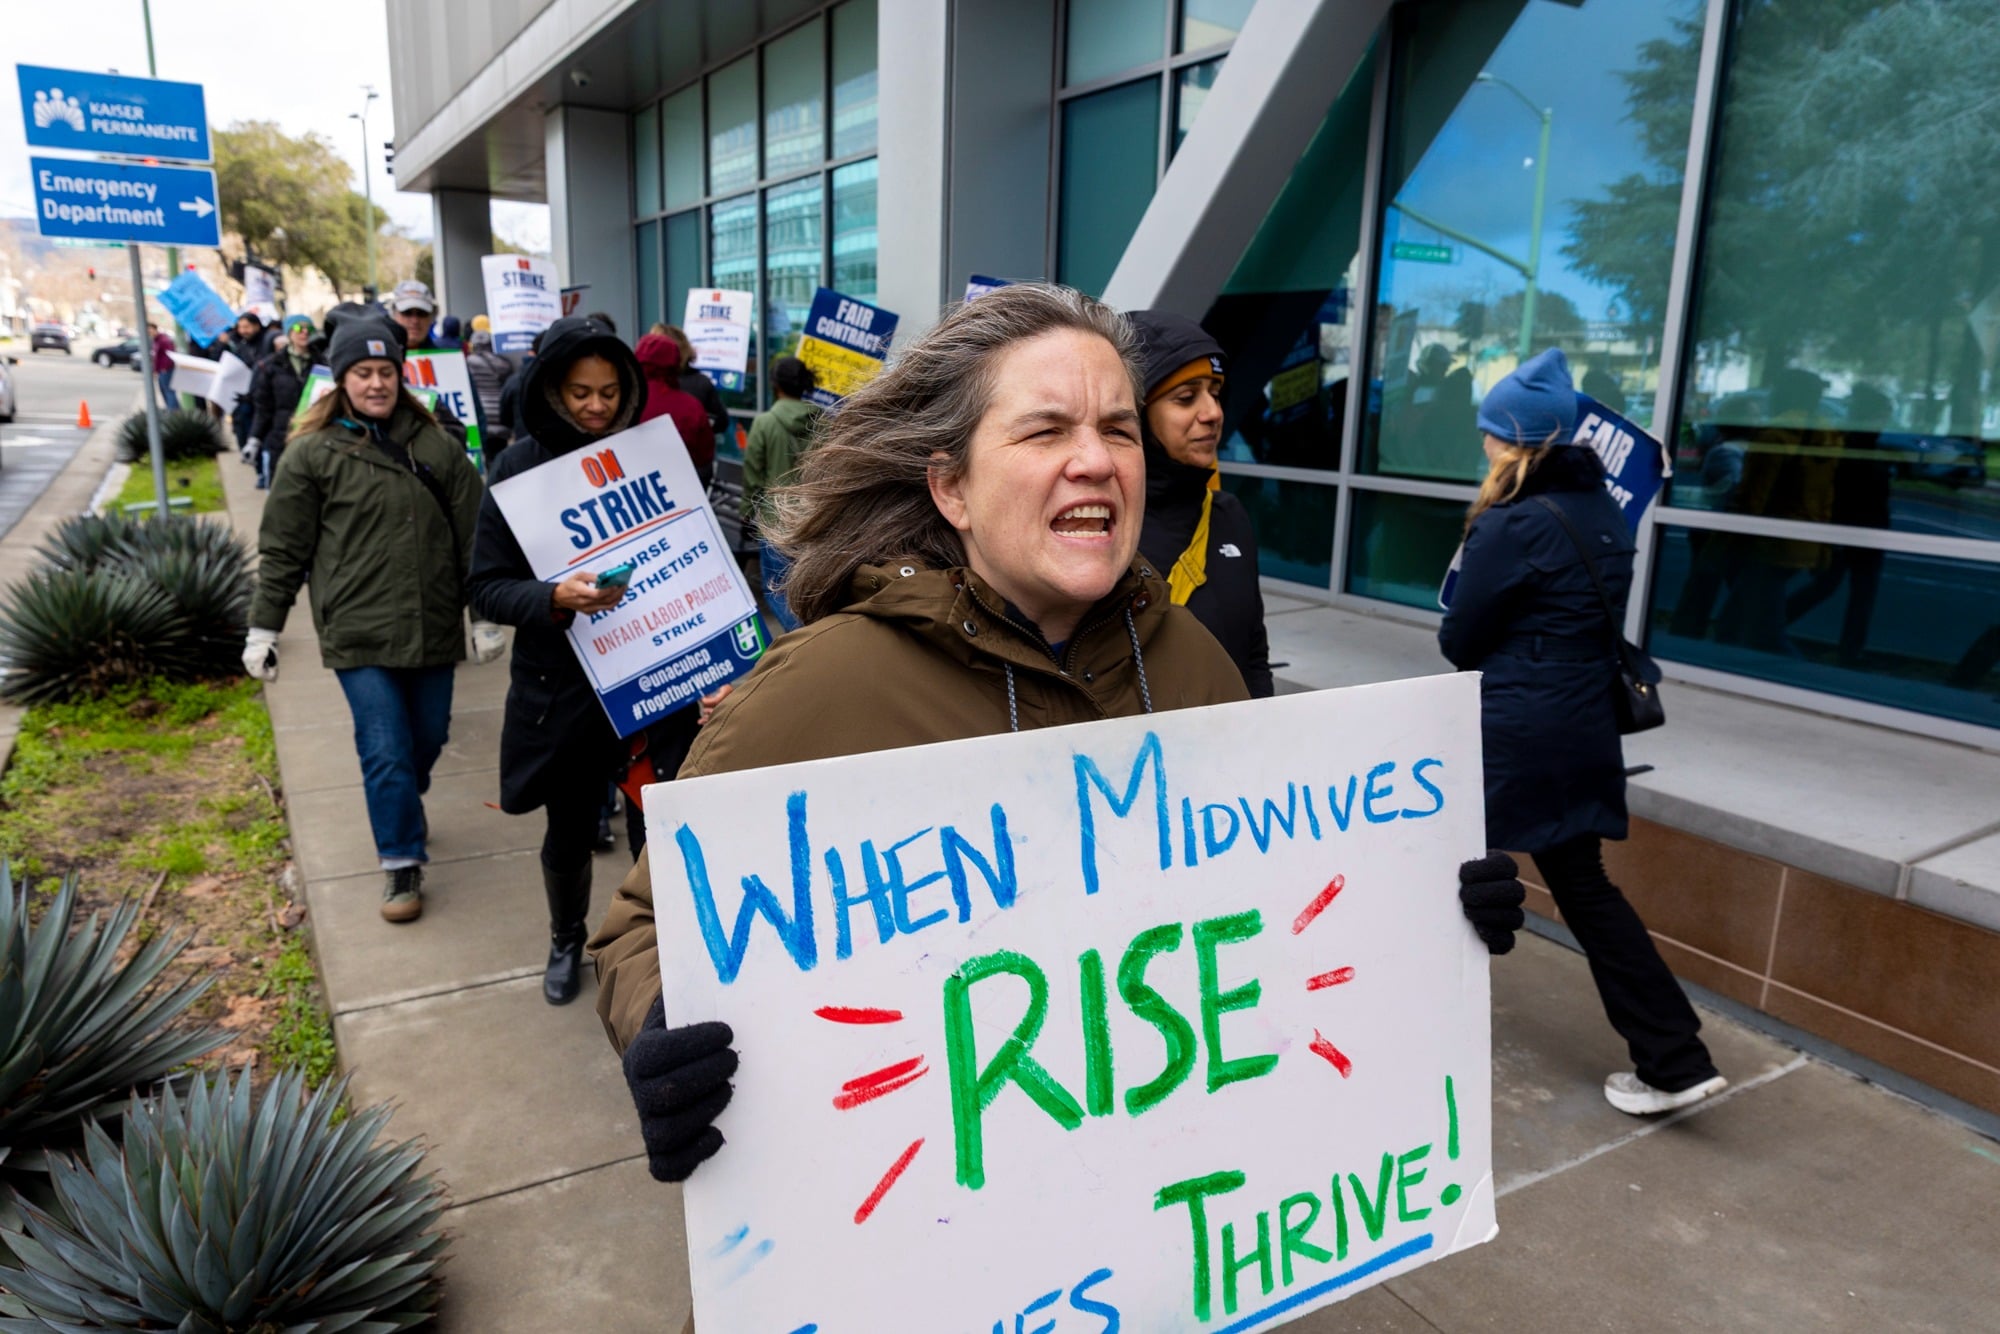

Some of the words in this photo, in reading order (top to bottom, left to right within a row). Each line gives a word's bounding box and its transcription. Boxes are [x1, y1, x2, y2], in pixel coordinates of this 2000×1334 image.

[89, 103, 144, 120] KAISER
[91, 119, 198, 142] PERMANENTE
[40, 170, 157, 203] Emergency
[44, 200, 165, 227] Department
[502, 271, 546, 292] STRIKE
[699, 304, 732, 320] STRIKE
[835, 299, 875, 331] FAIR
[815, 315, 882, 353] CONTRACT
[1571, 412, 1635, 479] FAIR
[581, 448, 625, 488] ON
[560, 470, 676, 550] STRIKE
[608, 537, 671, 572] URSE
[589, 540, 709, 625] ASTHETISTS
[593, 618, 646, 656] UNFAIR
[643, 597, 687, 632] LABOR
[684, 572, 733, 612] PRACTICE
[652, 612, 707, 647] STRIKE
[632, 658, 735, 721] #TogetherWeRise
[638, 648, 712, 692] @unacuhcp
[675, 790, 1018, 985] WHEN
[1072, 731, 1444, 895] MIDWIVES
[943, 908, 1280, 1190] RISE
[1153, 1075, 1464, 1323] THRIVE!
